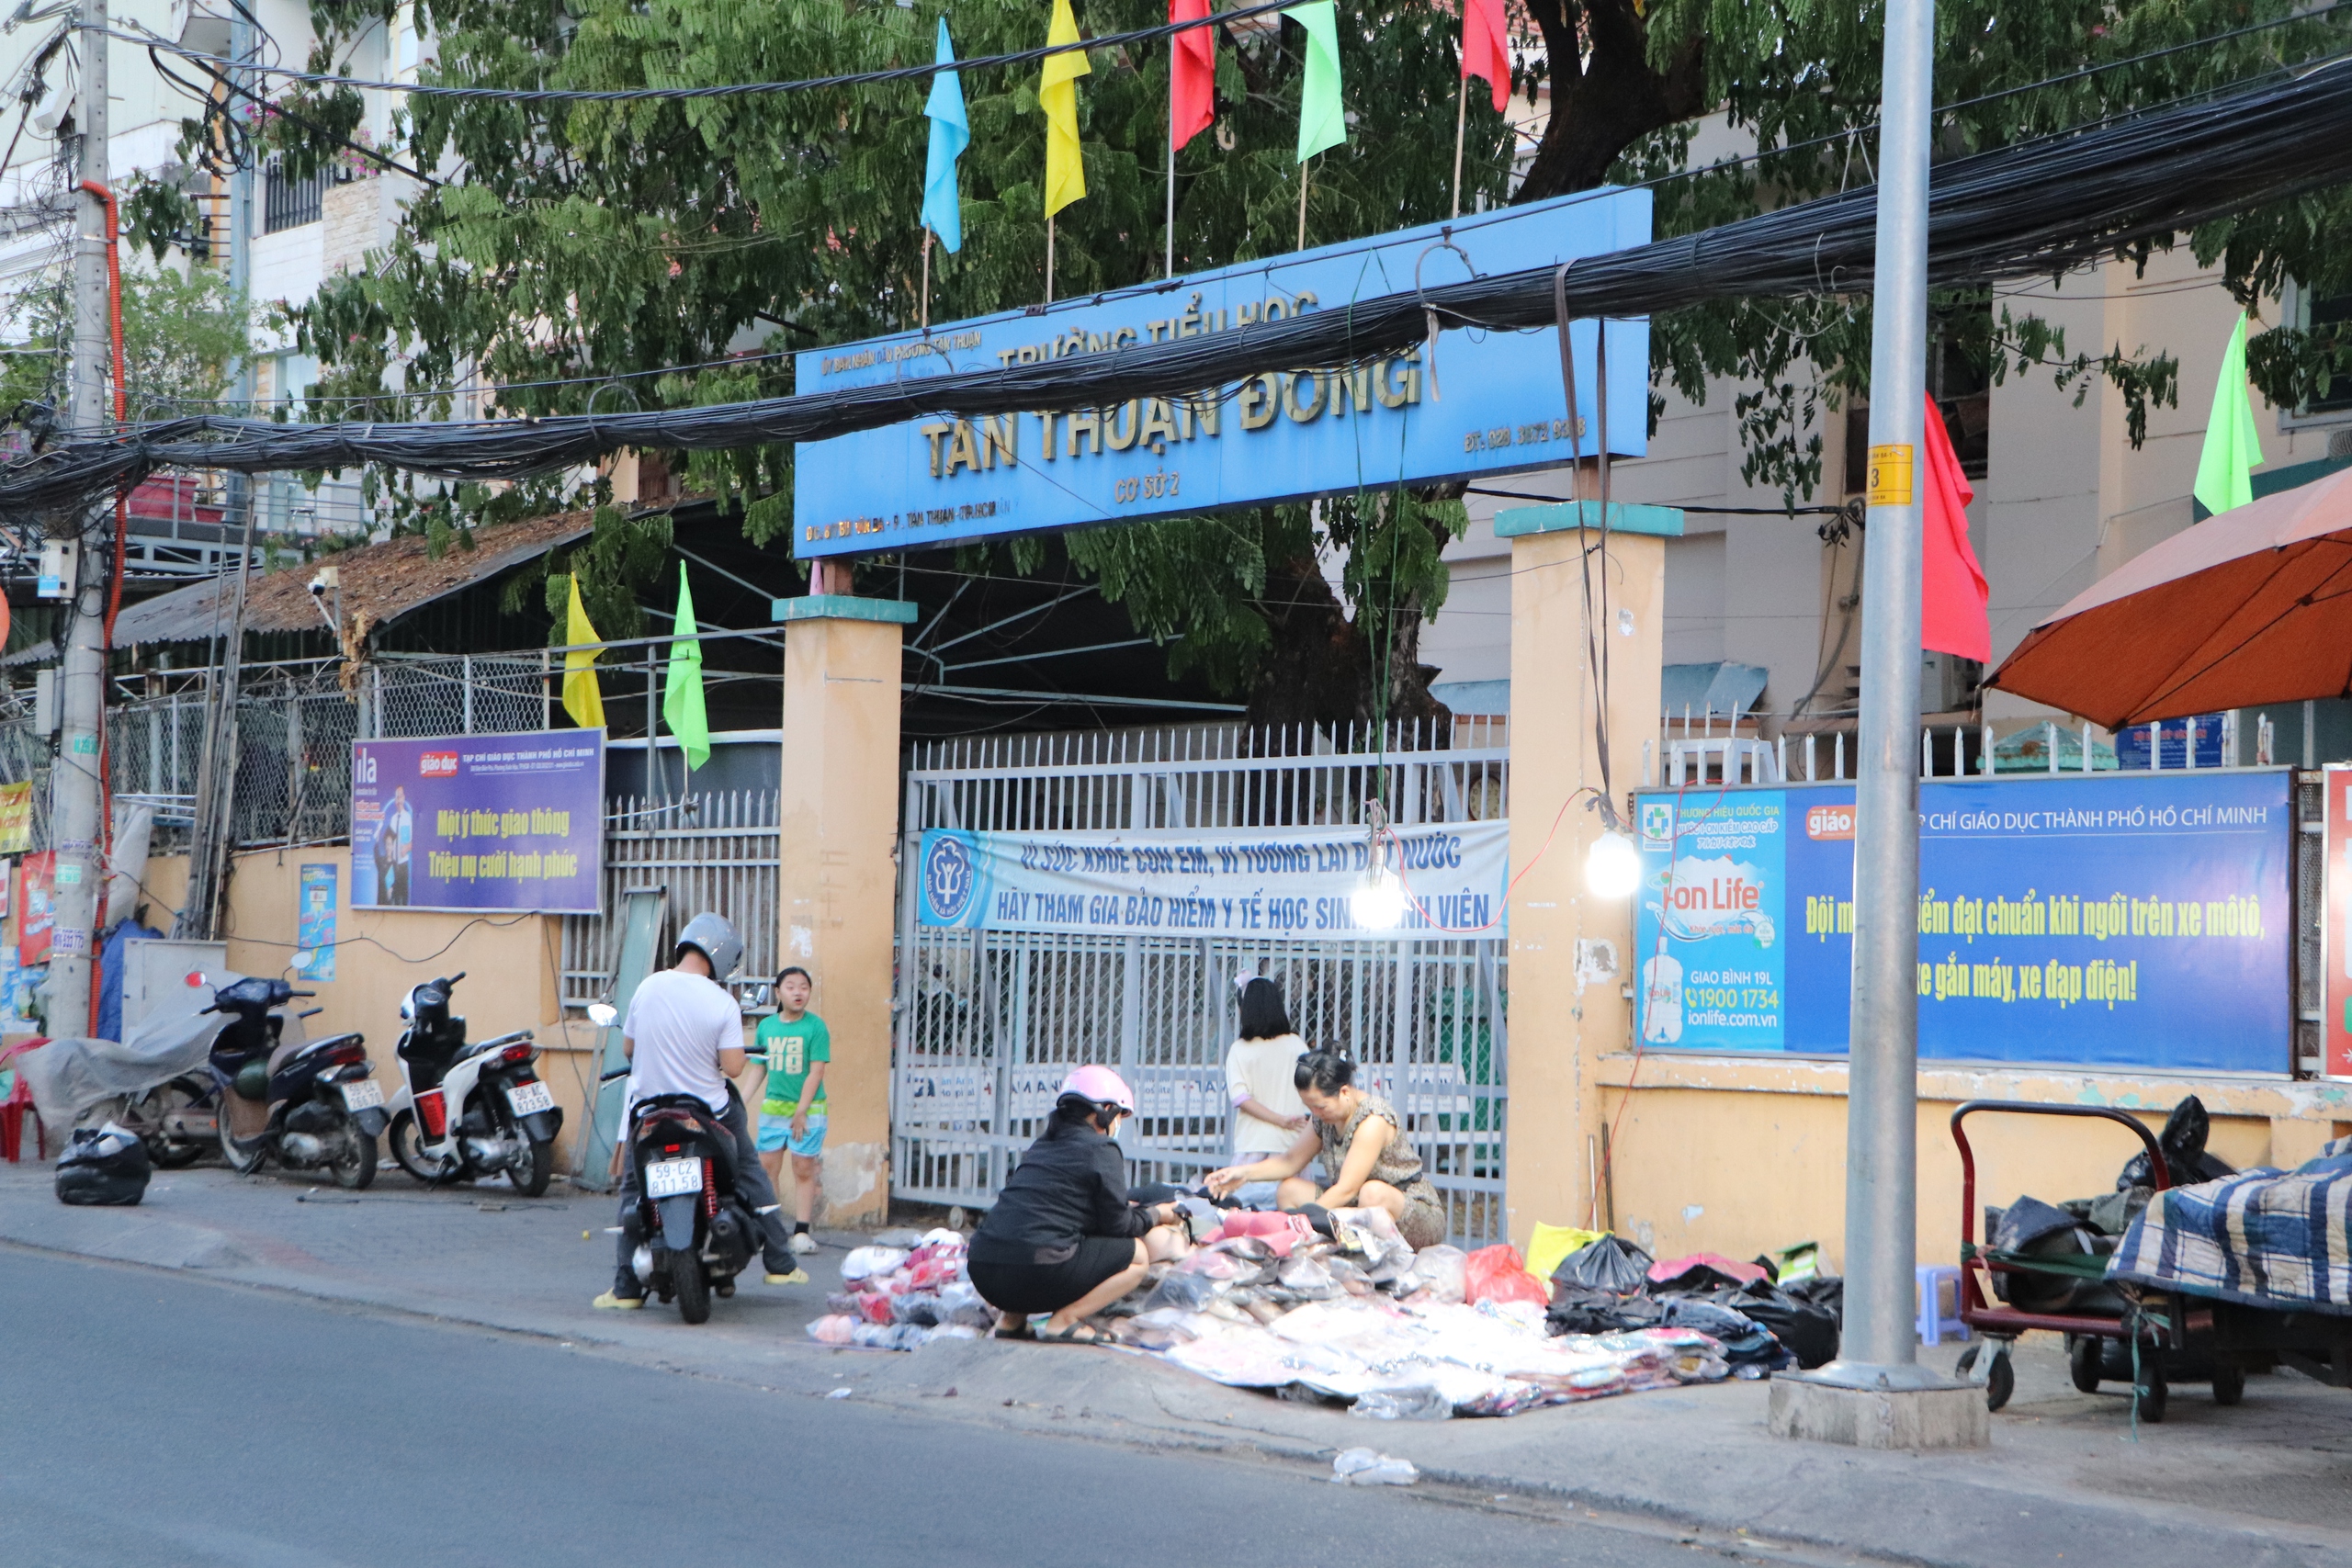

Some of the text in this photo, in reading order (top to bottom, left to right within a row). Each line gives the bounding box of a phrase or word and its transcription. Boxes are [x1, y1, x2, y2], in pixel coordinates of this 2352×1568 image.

[1114, 465, 1180, 504] CƠ SỞ 2
[1871, 468, 1880, 488] 3
[356, 747, 377, 784] ila
[421, 753, 440, 773] giáo
[441, 754, 458, 773] dục
[463, 753, 474, 764] TẠP
[475, 751, 486, 762] CHÍ
[487, 751, 502, 762] GIÁO
[516, 750, 538, 761] THÀNH
[538, 748, 552, 761] PHỐ
[563, 748, 576, 759] CHÍ
[576, 748, 594, 758] MINH
[1713, 806, 1734, 819] HIỆU
[1736, 802, 1761, 818] QUỐC
[1763, 806, 1780, 817] GIA
[1929, 810, 1957, 830] CHÍ
[1960, 809, 2001, 830] GIÁO
[2004, 812, 2041, 832] DỤC
[2042, 807, 2103, 829] THÀNH
[2108, 805, 2145, 827] PHỐ
[2150, 805, 2177, 826] HỒ
[2181, 804, 2213, 826] CHÍ
[2217, 806, 2267, 824] MINH
[436, 807, 570, 843] Một ý thức giao thông
[1741, 821, 1758, 833] CAO
[1809, 808, 1851, 836] giáo
[1021, 839, 1038, 870] VÌ
[1040, 840, 1079, 873] SỨC
[1133, 844, 1174, 874] CON
[1216, 841, 1238, 874] VÌ
[1238, 841, 1311, 874] TƯƠNG
[1314, 841, 1349, 873] LAI
[1399, 830, 1462, 871] NƯỚC
[428, 848, 578, 885] Triệu nụ cười hạnh phúc
[1713, 876, 1759, 910] Life
[997, 886, 1030, 921] HÃY
[1035, 892, 1085, 924] THAM
[1090, 895, 1119, 926] GIA
[1125, 886, 1163, 927] BẢO
[1168, 885, 1216, 929] HIỂM
[1222, 897, 1234, 929] Y
[1238, 887, 1264, 929] TẾ
[1268, 897, 1308, 936] HỌC
[1438, 887, 1489, 929] VIÊN
[1805, 895, 1834, 943] Đội
[1952, 895, 1984, 944] đạt
[1986, 887, 2046, 936] chuẩn
[2049, 894, 2080, 935] khi
[2083, 891, 2128, 942] ngồi
[2131, 894, 2174, 937] trên
[2177, 901, 2202, 937] xe
[2206, 893, 2266, 941] môtô,
[1690, 967, 1773, 985] GIAO BÌNH 19L
[1935, 951, 1970, 1001] gắn
[1973, 956, 2017, 1003] máy,
[2018, 964, 2042, 999] xe
[2044, 958, 2082, 1010] đạp
[2085, 958, 2137, 1010] điện!
[1699, 987, 1779, 1009] 1900 1734
[1688, 1009, 1778, 1028] ionlife.com.vn
[768, 1036, 803, 1054] wa
[769, 1053, 803, 1074] ng
[656, 1161, 693, 1179] 59-C2
[652, 1175, 698, 1193] 811.58
